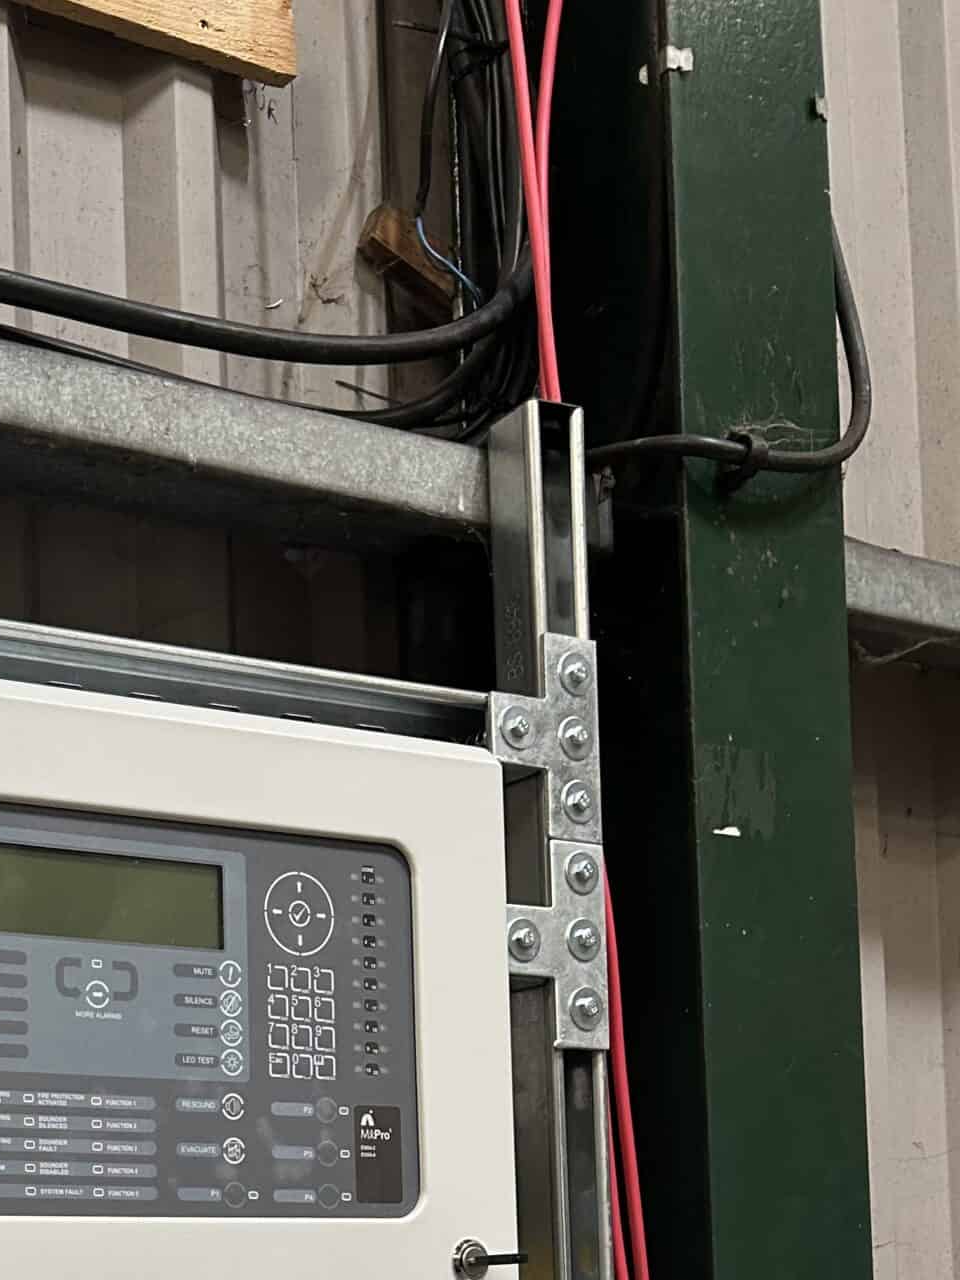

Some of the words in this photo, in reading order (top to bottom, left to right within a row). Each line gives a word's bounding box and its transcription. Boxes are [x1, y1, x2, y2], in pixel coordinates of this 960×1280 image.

[193, 968, 213, 976] MUTE
[267, 963, 272, 973] 1
[291, 966, 297, 976] 2
[314, 967, 320, 978] 3
[184, 996, 213, 1006] SILENCE
[268, 995, 274, 1004] 4
[292, 996, 298, 1006] 5
[315, 998, 321, 1008] 6
[192, 1026, 214, 1035] RESET
[268, 1024, 274, 1033] 7
[292, 1024, 298, 1034] 8
[316, 1026, 322, 1036] 9
[182, 1056, 196, 1064] LED
[198, 1056, 214, 1065] TEST
[292, 1055, 298, 1065] 0
[182, 1102, 216, 1110] RESOUND
[181, 1146, 216, 1154] EVACUATE
